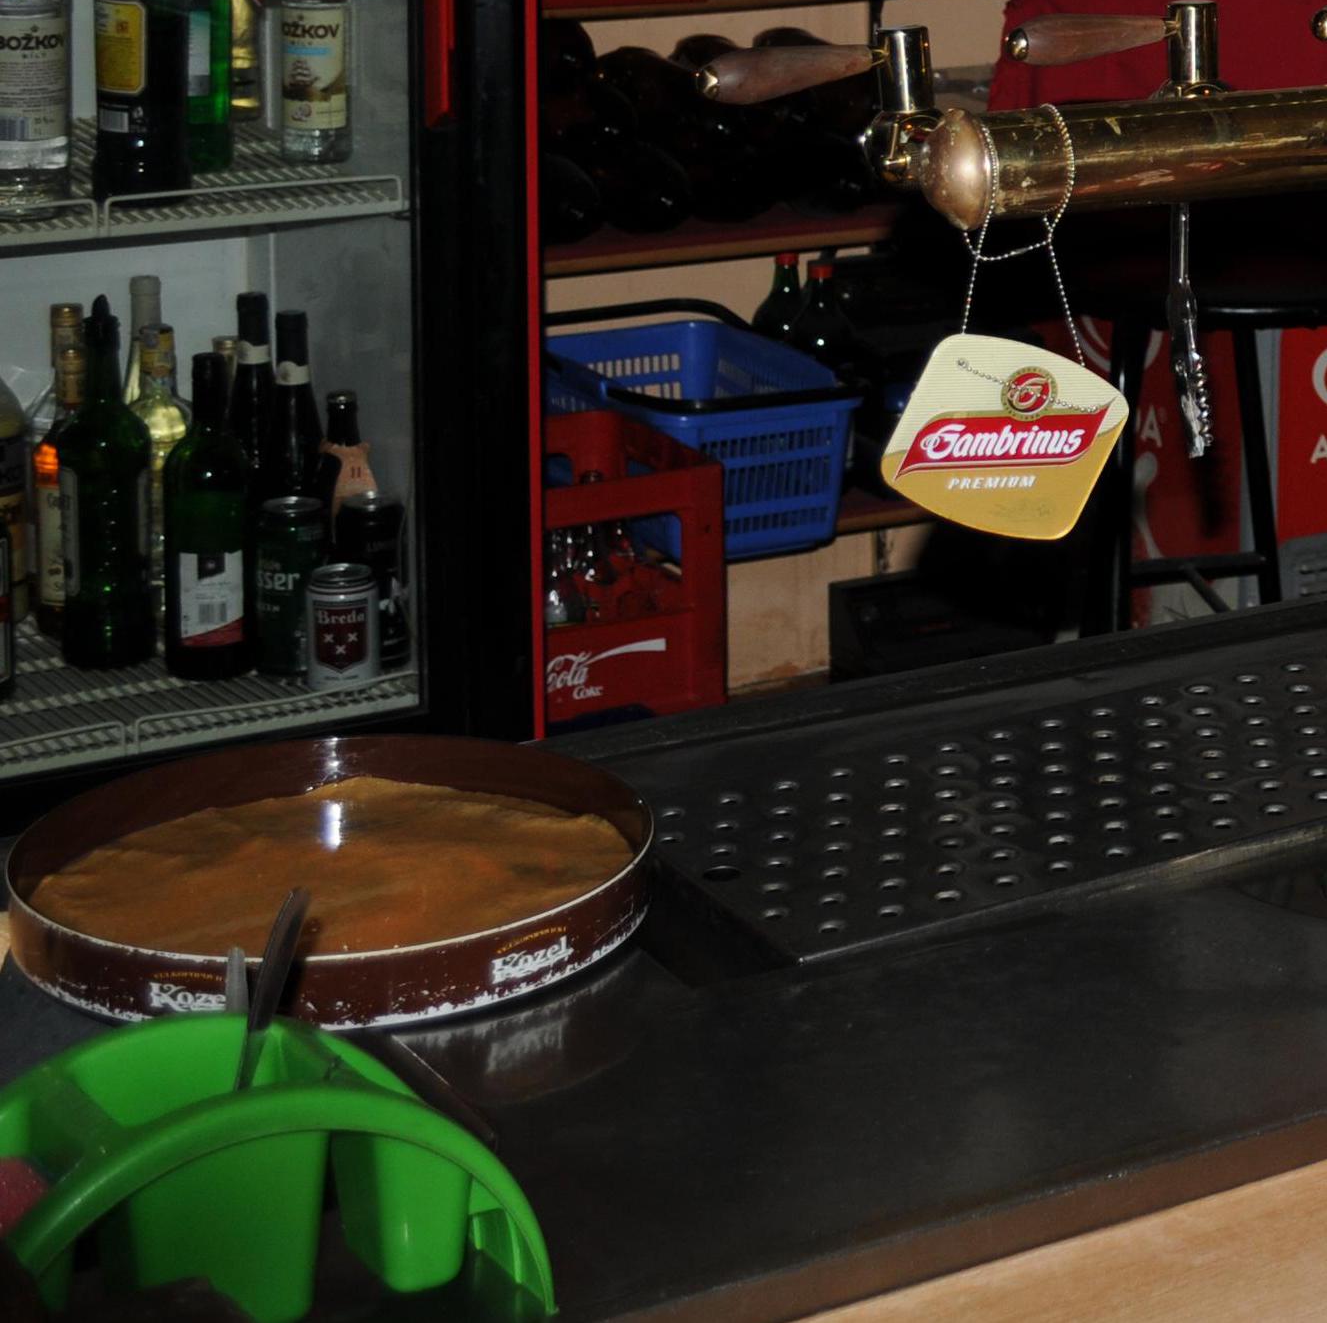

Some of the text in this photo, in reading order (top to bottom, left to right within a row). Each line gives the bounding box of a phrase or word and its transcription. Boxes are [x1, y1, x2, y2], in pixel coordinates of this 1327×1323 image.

[282, 21, 340, 39] OŽKOV
[919, 424, 1086, 460] Gambrinus
[947, 475, 1037, 491] PREMIUM
[572, 684, 604, 700] Coke
[491, 935, 574, 985] Kozel
[149, 981, 227, 1011] Koze
